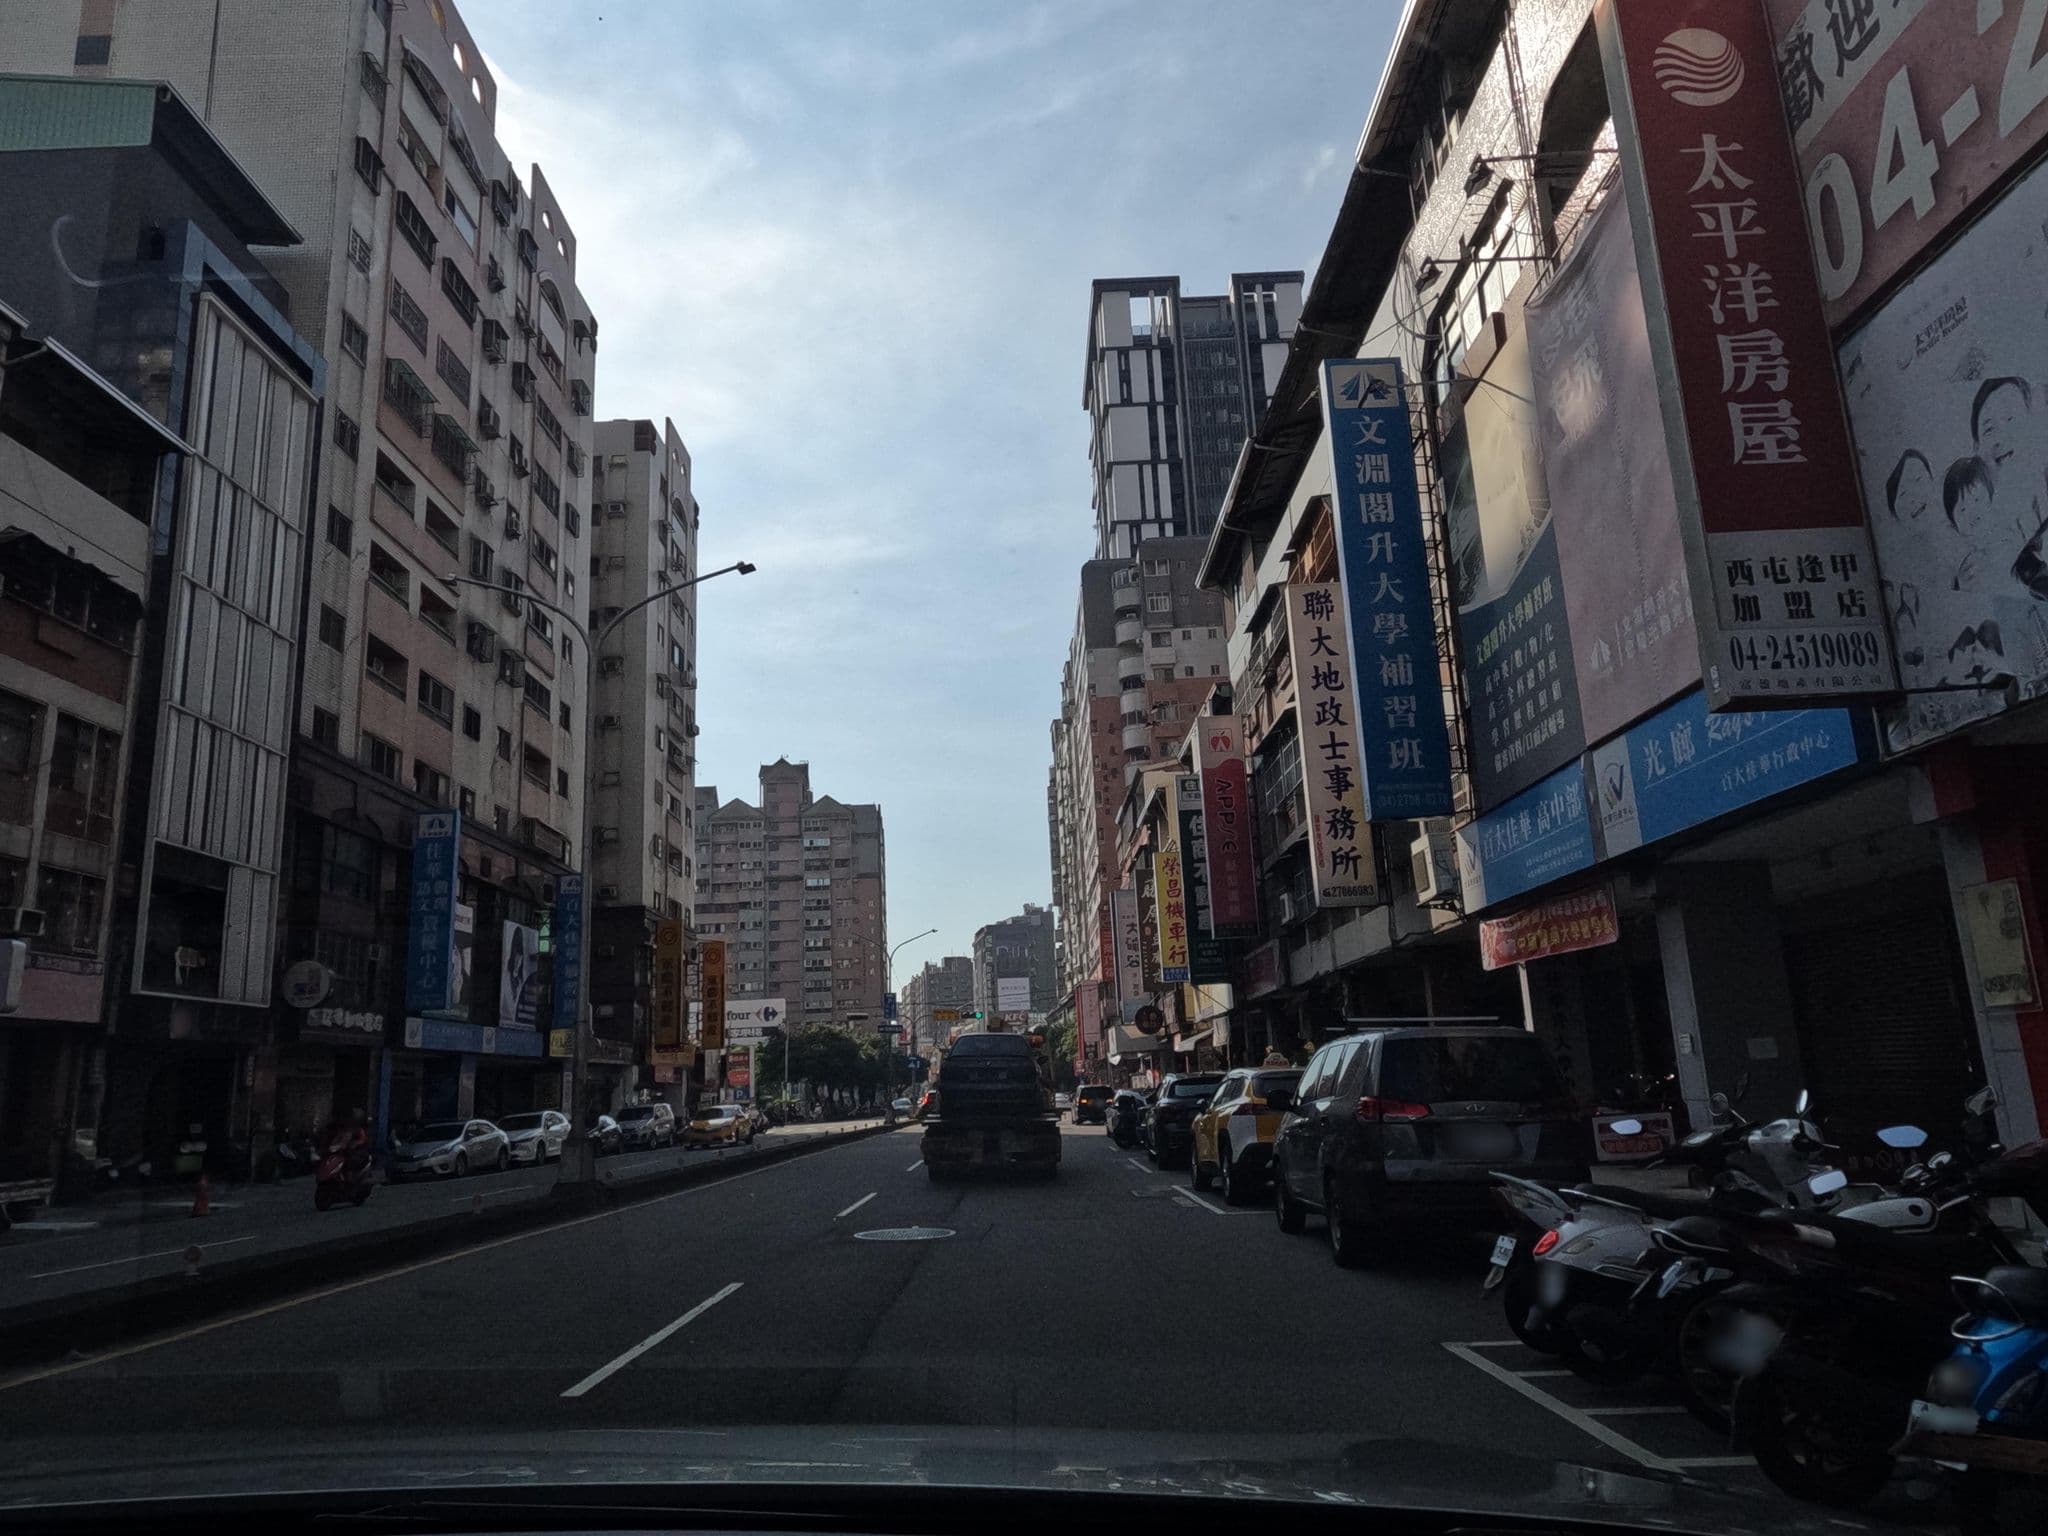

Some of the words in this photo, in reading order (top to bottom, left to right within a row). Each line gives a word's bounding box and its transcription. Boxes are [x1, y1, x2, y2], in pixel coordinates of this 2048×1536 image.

[1777, 0, 1899, 133] 歡迎
[1680, 133, 1808, 466] 太平洋房屋
[1352, 414, 1426, 773] 文淵閣升大學補習班
[1726, 553, 1859, 588] 西屯逢甲
[1733, 588, 1867, 623] 加盟店
[1730, 632, 1879, 671] 04-24519089
[1301, 589, 1362, 881] 聯大地政士事務所
[1536, 781, 1584, 834] 高中部
[1162, 856, 1187, 965] 榮昌機車行
[1004, 1013, 1027, 1022] KFC
[736, 1089, 744, 1099] P
